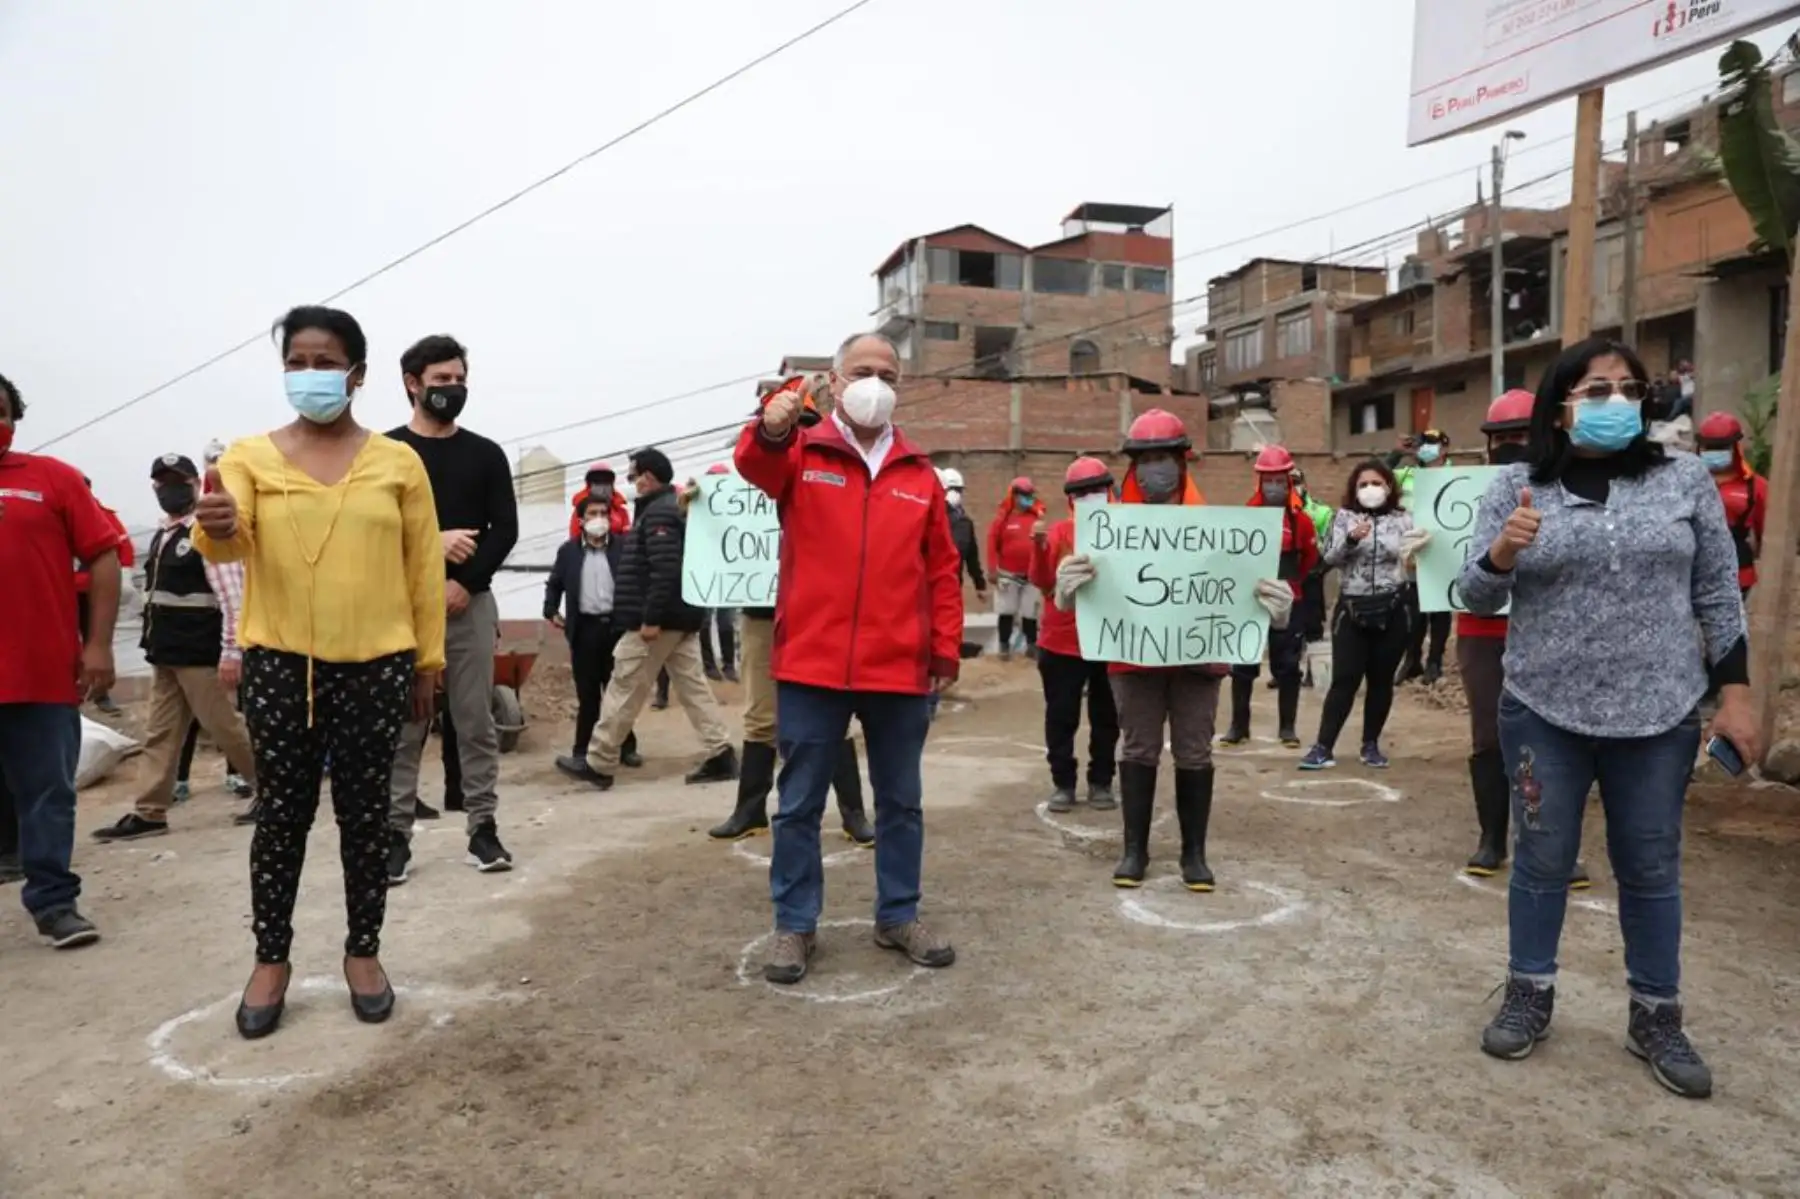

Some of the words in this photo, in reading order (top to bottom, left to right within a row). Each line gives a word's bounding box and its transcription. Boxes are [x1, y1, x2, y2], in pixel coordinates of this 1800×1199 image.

[707, 479, 777, 517] ESTA
[1088, 509, 1267, 556] BIENVENIDO
[1124, 563, 1236, 607] SEÑOR
[1097, 613, 1262, 664] MINISTRO
